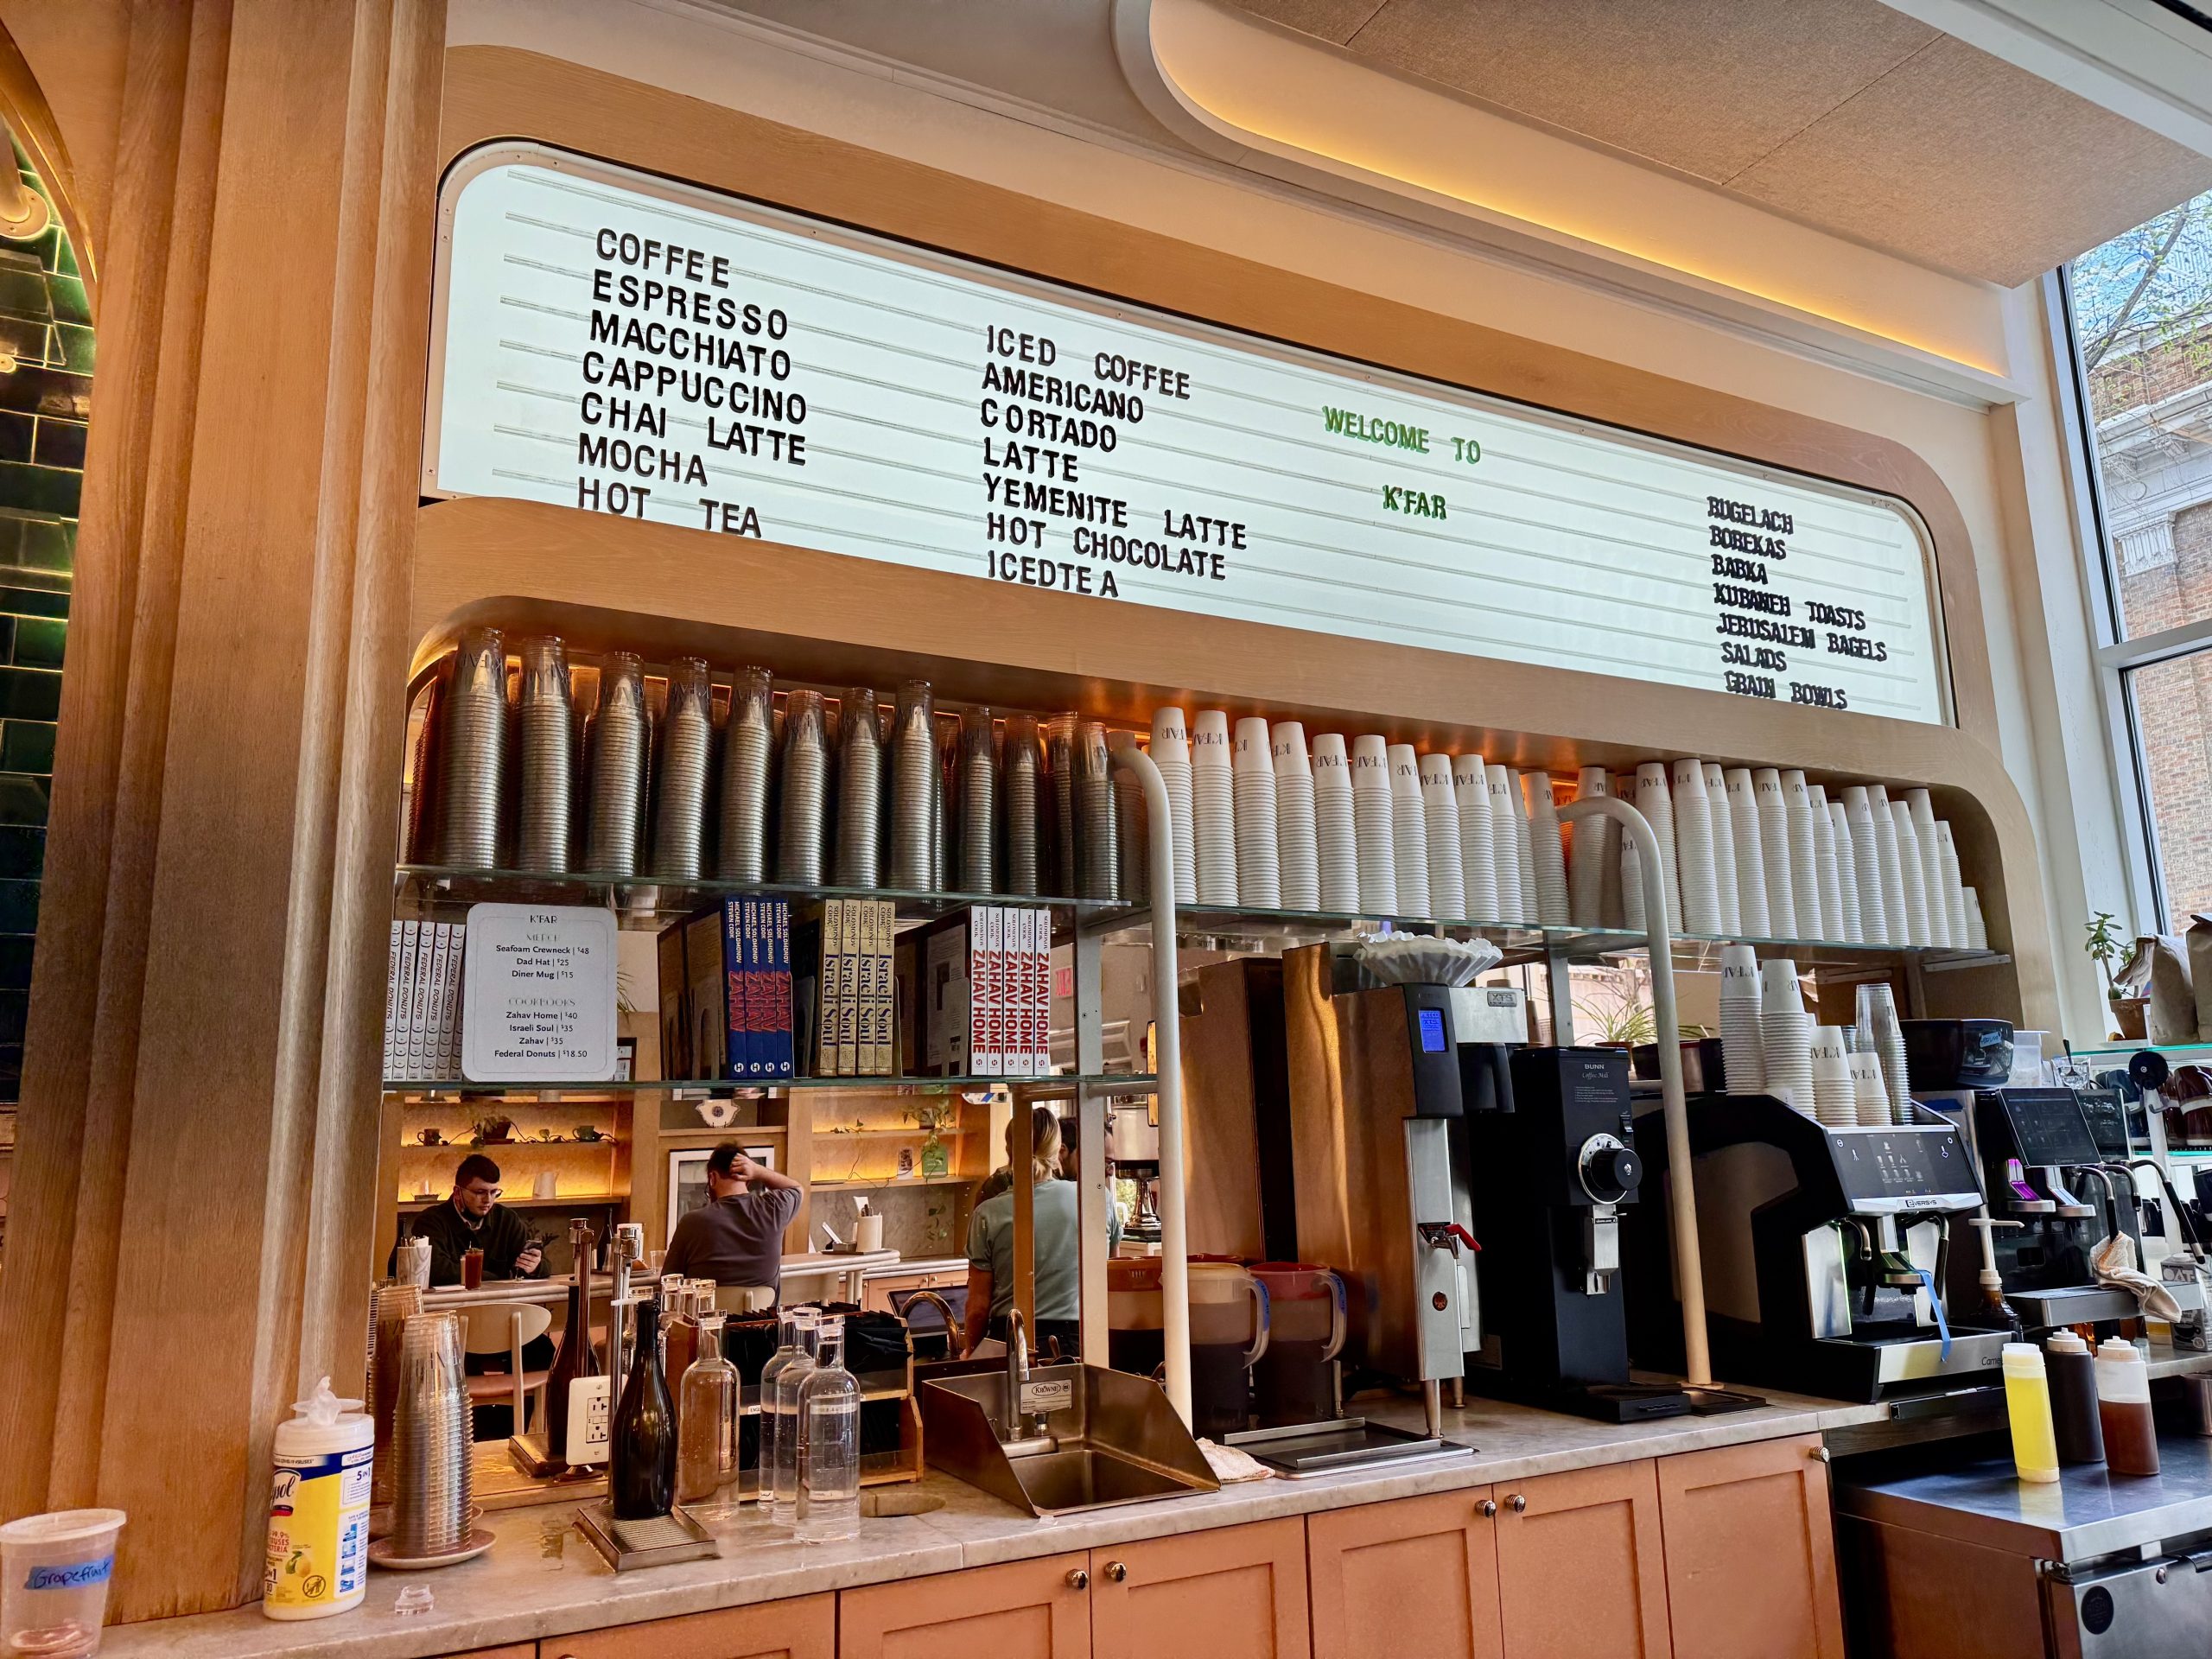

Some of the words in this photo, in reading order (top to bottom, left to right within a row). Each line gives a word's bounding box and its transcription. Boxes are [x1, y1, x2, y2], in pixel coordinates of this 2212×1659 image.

[596, 227, 730, 289] COFFEE
[593, 269, 787, 340] ESPRESSO
[590, 309, 791, 380] MACCHIATO
[987, 325, 1056, 366] ICED
[1094, 352, 1191, 399] COFFEE
[582, 351, 806, 424] CAPPUCCINO
[982, 362, 1143, 423] AMERICANO
[581, 391, 666, 438] CHAI
[707, 416, 806, 466] LATTE
[981, 398, 1116, 452] CORTADO
[1322, 405, 1430, 454] WELCOME
[1451, 436, 1481, 464] TO
[578, 432, 708, 486] MOCHA
[983, 436, 1078, 482] LATTE
[578, 476, 651, 518] HOT
[699, 498, 761, 537] TEA
[982, 473, 1128, 528] YEMENITE
[1164, 509, 1247, 550] LATTE
[1382, 485, 1447, 520] K'FAR
[987, 512, 1046, 549] HOT
[1073, 527, 1226, 580] CHOCOLATE
[1709, 525, 1786, 560] BOREKAS
[1711, 554, 1768, 585] BABKA
[1713, 582, 1791, 616] KUBANEH
[1804, 601, 1866, 631] TOASTS
[1716, 613, 1815, 649] JERUSALEM
[1826, 632, 1887, 662] BAGELS
[1720, 642, 1787, 671] SALADS
[1724, 671, 1776, 698] GRAIN
[1789, 682, 1847, 709] BOWLS
[530, 915, 558, 924] K'FAR
[404, 951, 412, 987] FEDERAL
[419, 951, 429, 987] FEDERAL
[434, 953, 443, 986] FEDERAL
[448, 954, 459, 987] FEDERAL
[496, 944, 531, 953] Seafoam
[536, 970, 555, 980] Mug
[562, 970, 574, 979] $15
[823, 954, 839, 1004] Israeli
[842, 952, 857, 1003] Israeli
[861, 953, 875, 1003] Israeli
[878, 954, 893, 1004] Israeli
[973, 950, 986, 1005] ZAHAV
[988, 950, 1001, 1005] ZAHAV
[1005, 951, 1018, 1005] ZAHAV
[1020, 951, 1033, 1006] ZAHAV
[1037, 952, 1049, 1007] ZAHAV
[400, 988, 409, 1020] DONUTS
[416, 988, 425, 1020] DONUTS
[431, 989, 440, 1021] DONUTS
[445, 989, 454, 1023] DONUTS
[728, 971, 746, 1032] ZAHAV
[745, 971, 761, 1032] ZAHAV
[760, 971, 777, 1032] ZAHAV
[776, 971, 791, 1032] ZAHAV
[823, 1007, 837, 1046] Soul
[841, 1007, 855, 1045] Soul
[860, 1007, 874, 1045] Soul
[877, 1007, 892, 1046] Soul
[973, 1007, 986, 1054] HOME
[988, 1007, 1001, 1054] HOME
[1005, 1008, 1018, 1054] HOME
[1020, 1008, 1033, 1054] HOME
[1036, 1009, 1049, 1054] HOME
[1582, 1071, 1597, 1080] Coffee
[35, 1560, 111, 1589] Grapefruit
